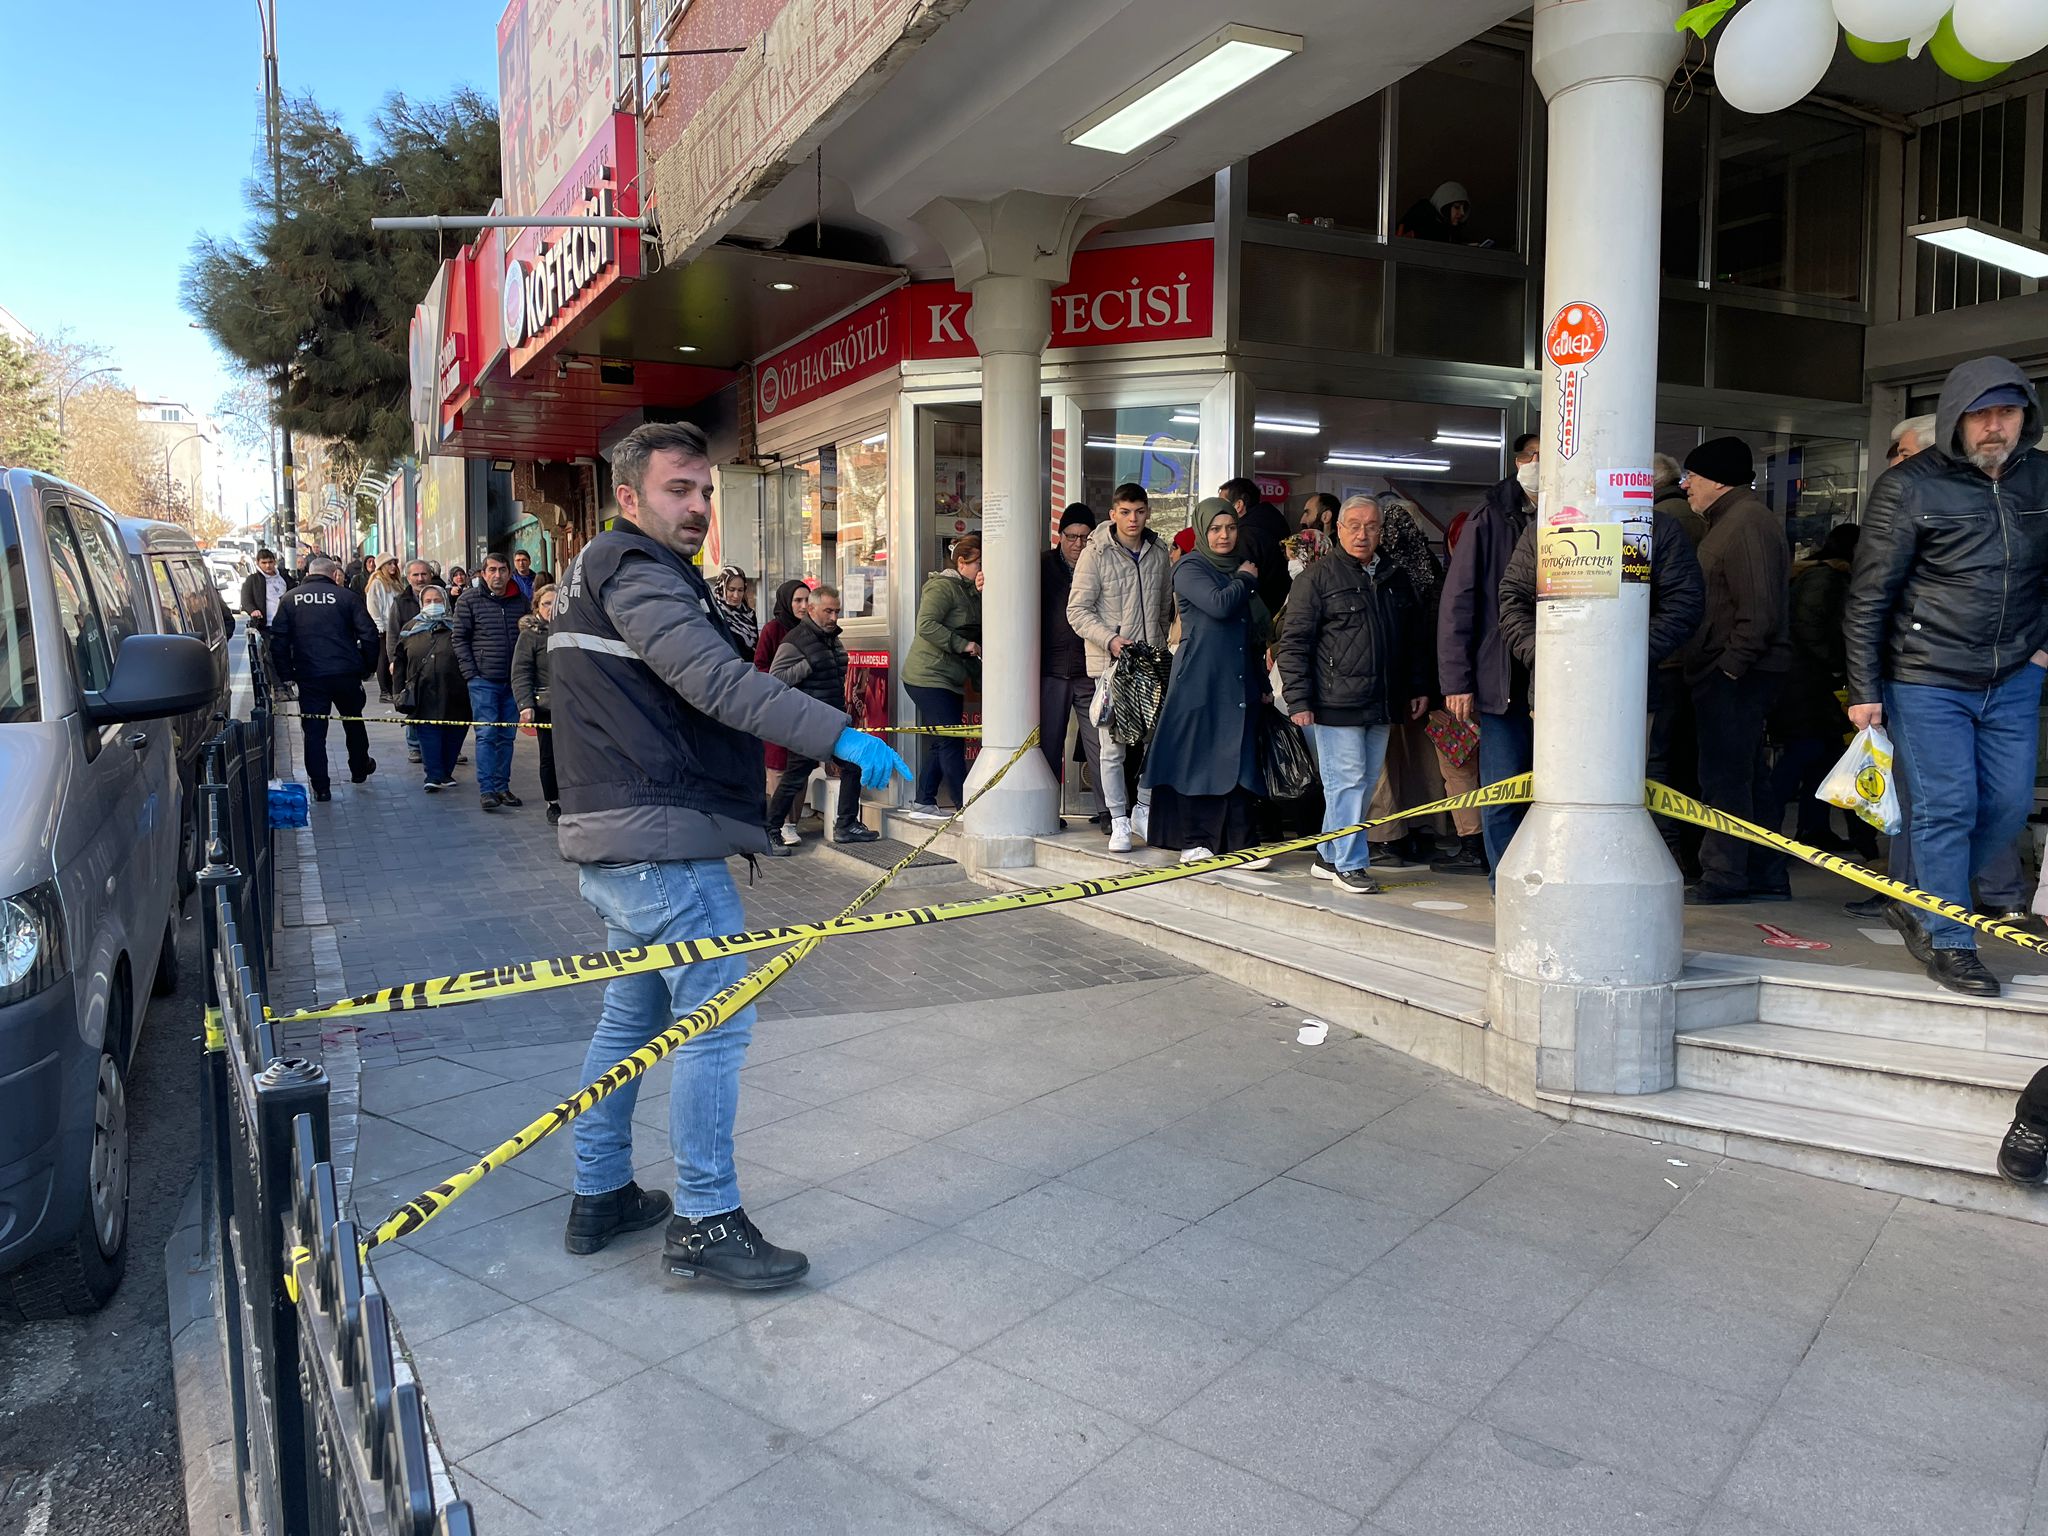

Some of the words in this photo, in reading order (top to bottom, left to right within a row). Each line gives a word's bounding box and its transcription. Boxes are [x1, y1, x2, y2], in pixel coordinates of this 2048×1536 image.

[781, 359, 799, 400] ÖZ
[800, 308, 890, 391] HACIKÖYLÜ
[1564, 369, 1575, 456] ANAHTARCI
[294, 592, 337, 606] POLİS
